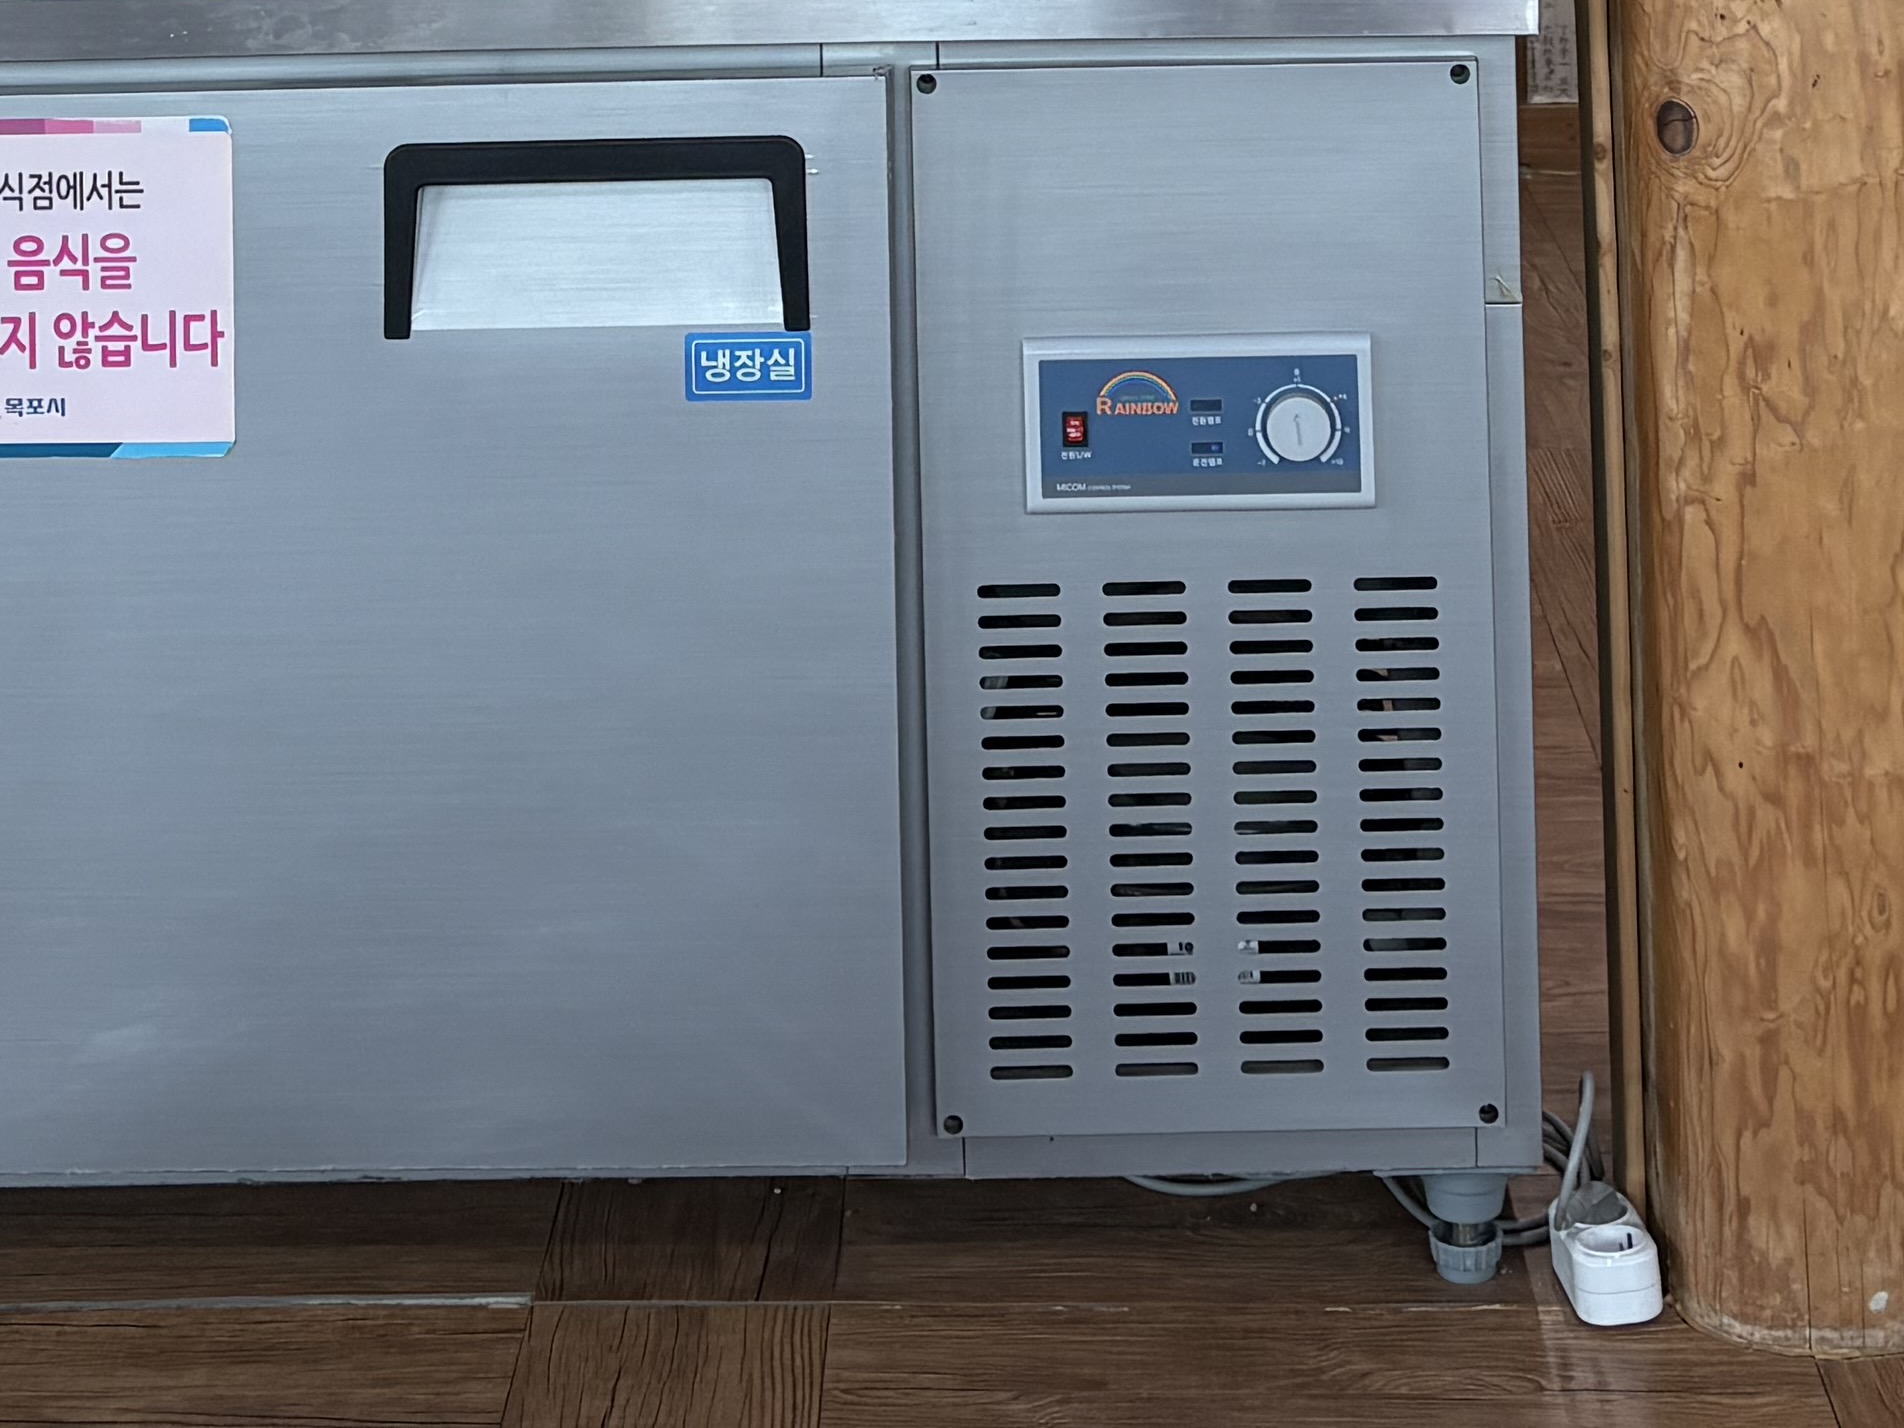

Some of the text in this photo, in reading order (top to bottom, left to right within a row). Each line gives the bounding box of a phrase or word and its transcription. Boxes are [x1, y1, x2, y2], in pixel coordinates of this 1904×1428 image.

[7, 233, 137, 291] 음식을
[53, 309, 225, 370] 않습니다
[701, 348, 795, 382] 냉장실
[4, 397, 66, 417] 목포시
